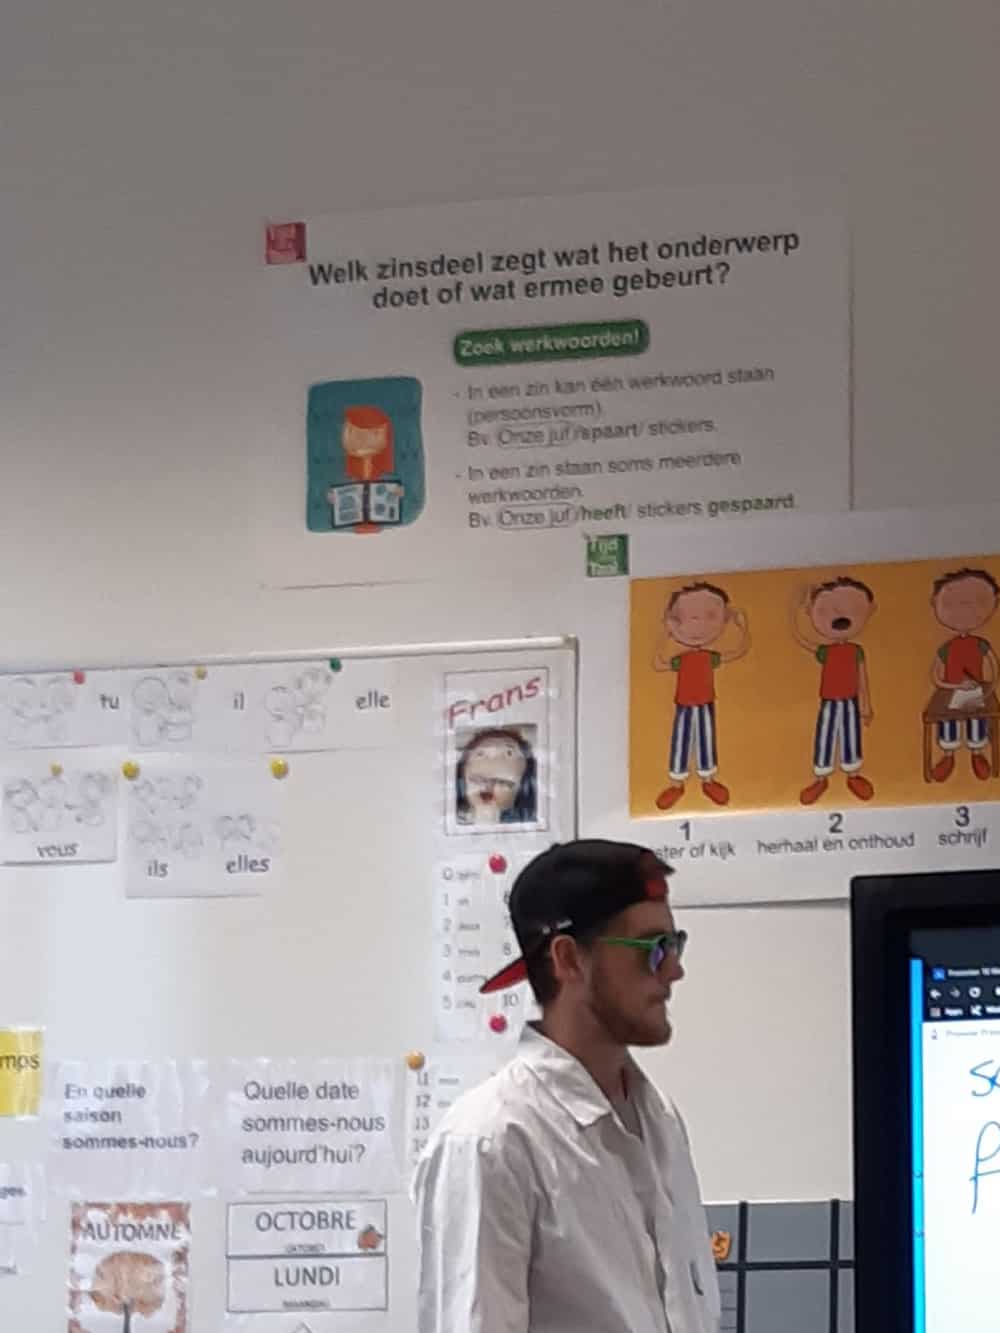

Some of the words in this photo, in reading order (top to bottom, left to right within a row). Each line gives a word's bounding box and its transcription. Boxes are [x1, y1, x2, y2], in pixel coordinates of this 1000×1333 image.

[308, 259, 368, 286] Welk
[376, 251, 483, 281] zinsdeel
[491, 247, 547, 276] zegt
[553, 244, 600, 269] wat
[608, 241, 649, 264] het
[656, 232, 799, 260] onderwerp
[372, 286, 430, 309] doet
[437, 280, 463, 305] of
[470, 279, 516, 302] wat
[524, 274, 604, 299] ermee
[612, 260, 731, 297] gebeurt?
[459, 337, 504, 358] Zoek
[509, 327, 641, 353] werkwoorden!
[628, 370, 722, 391] werkwoord
[727, 366, 775, 386] staan
[555, 460, 602, 476] staan
[607, 457, 654, 474] soms
[99, 693, 120, 710] tu
[232, 691, 245, 710] il
[354, 690, 391, 709] elle
[448, 677, 542, 729] Frans
[829, 813, 844, 834] 2
[955, 806, 971, 827] 3
[680, 821, 692, 841] 1
[938, 828, 988, 848] schrijf
[689, 841, 706, 859] of
[709, 841, 737, 861] kijk
[757, 836, 819, 855] herhaal
[822, 836, 844, 851] en
[848, 832, 915, 850] onthoud
[147, 859, 168, 878] ils
[225, 854, 270, 874] elles
[64, 1083, 89, 1099] En
[93, 1083, 147, 1101] quelle
[244, 1080, 310, 1101] Quelle
[315, 1081, 360, 1101] date
[63, 1109, 122, 1124] saison
[241, 1116, 386, 1132] sommes-nous
[62, 1132, 200, 1150] sommes-nous?
[241, 1143, 366, 1168] aujourd'hui?
[255, 1210, 357, 1232] OCTOBRE
[82, 1222, 182, 1241] AUTOMNE
[274, 1266, 341, 1287] LUNDI
